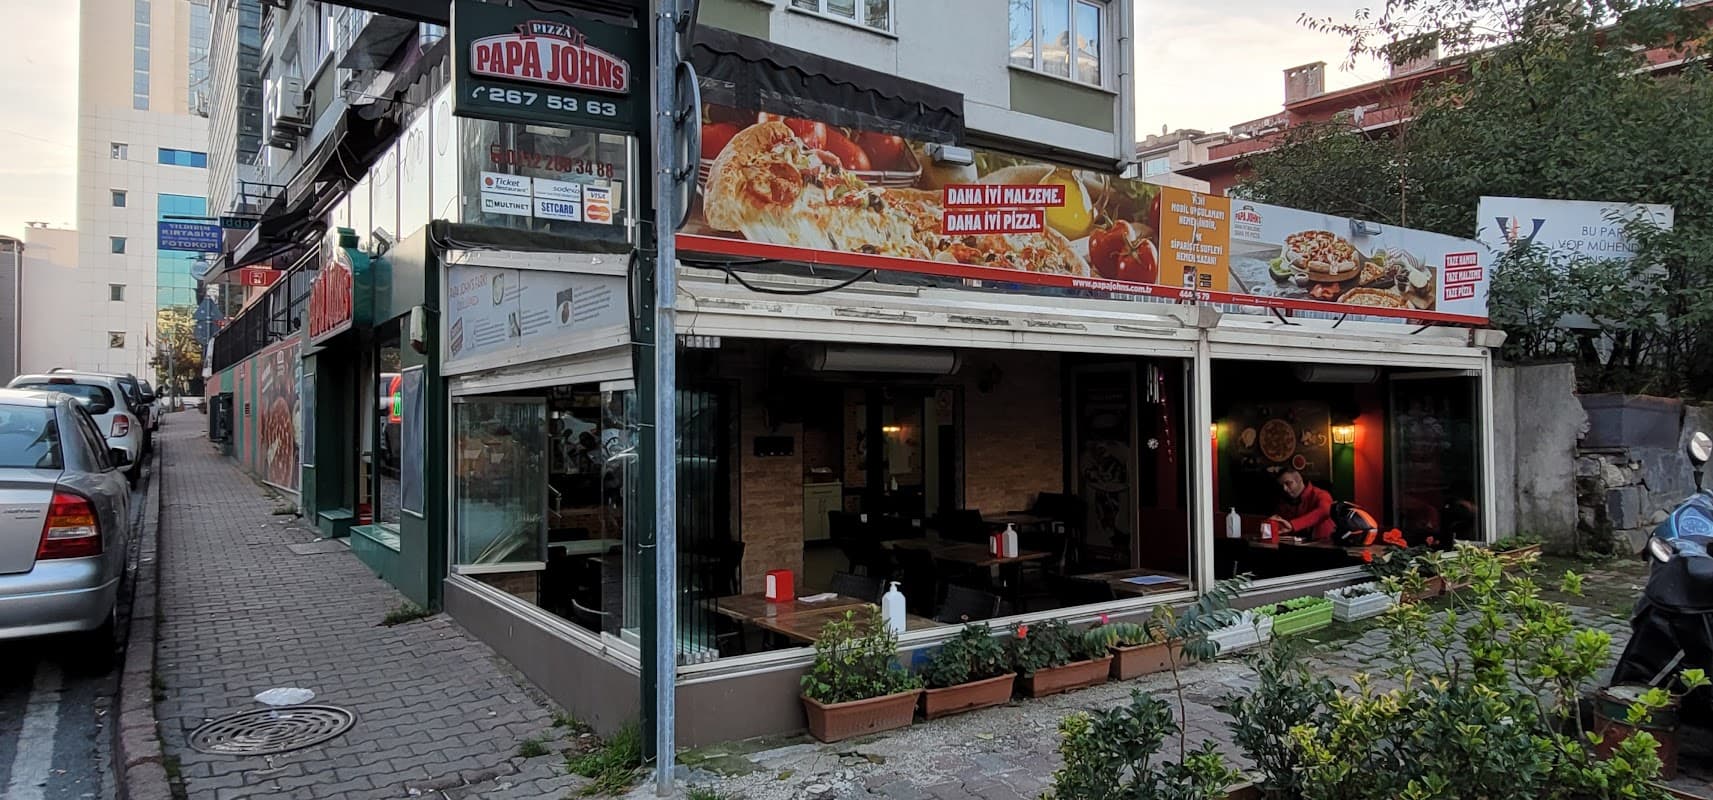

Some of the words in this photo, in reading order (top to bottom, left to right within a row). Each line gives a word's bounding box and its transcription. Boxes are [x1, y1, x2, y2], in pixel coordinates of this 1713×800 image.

[533, 23, 572, 38] PIZZA
[477, 41, 543, 78] PAPA
[489, 90, 538, 105] 267
[547, 96, 578, 111] 53
[587, 101, 617, 116] 63
[576, 159, 593, 176] 34
[495, 177, 520, 187] Ticket
[948, 188, 982, 205] DAHA
[985, 185, 1001, 204] İYİ
[1004, 188, 1061, 204] MALZEME.
[494, 202, 529, 211] MULTINET
[541, 202, 574, 214] SETCARD
[947, 214, 982, 231] DAHA
[984, 211, 1000, 230] İYİ
[1003, 211, 1041, 230] PİZZA.
[162, 229, 218, 238] KIRTASİYE
[1582, 226, 1597, 236] BU
[1072, 279, 1153, 294] www.papajohns.com.tr
